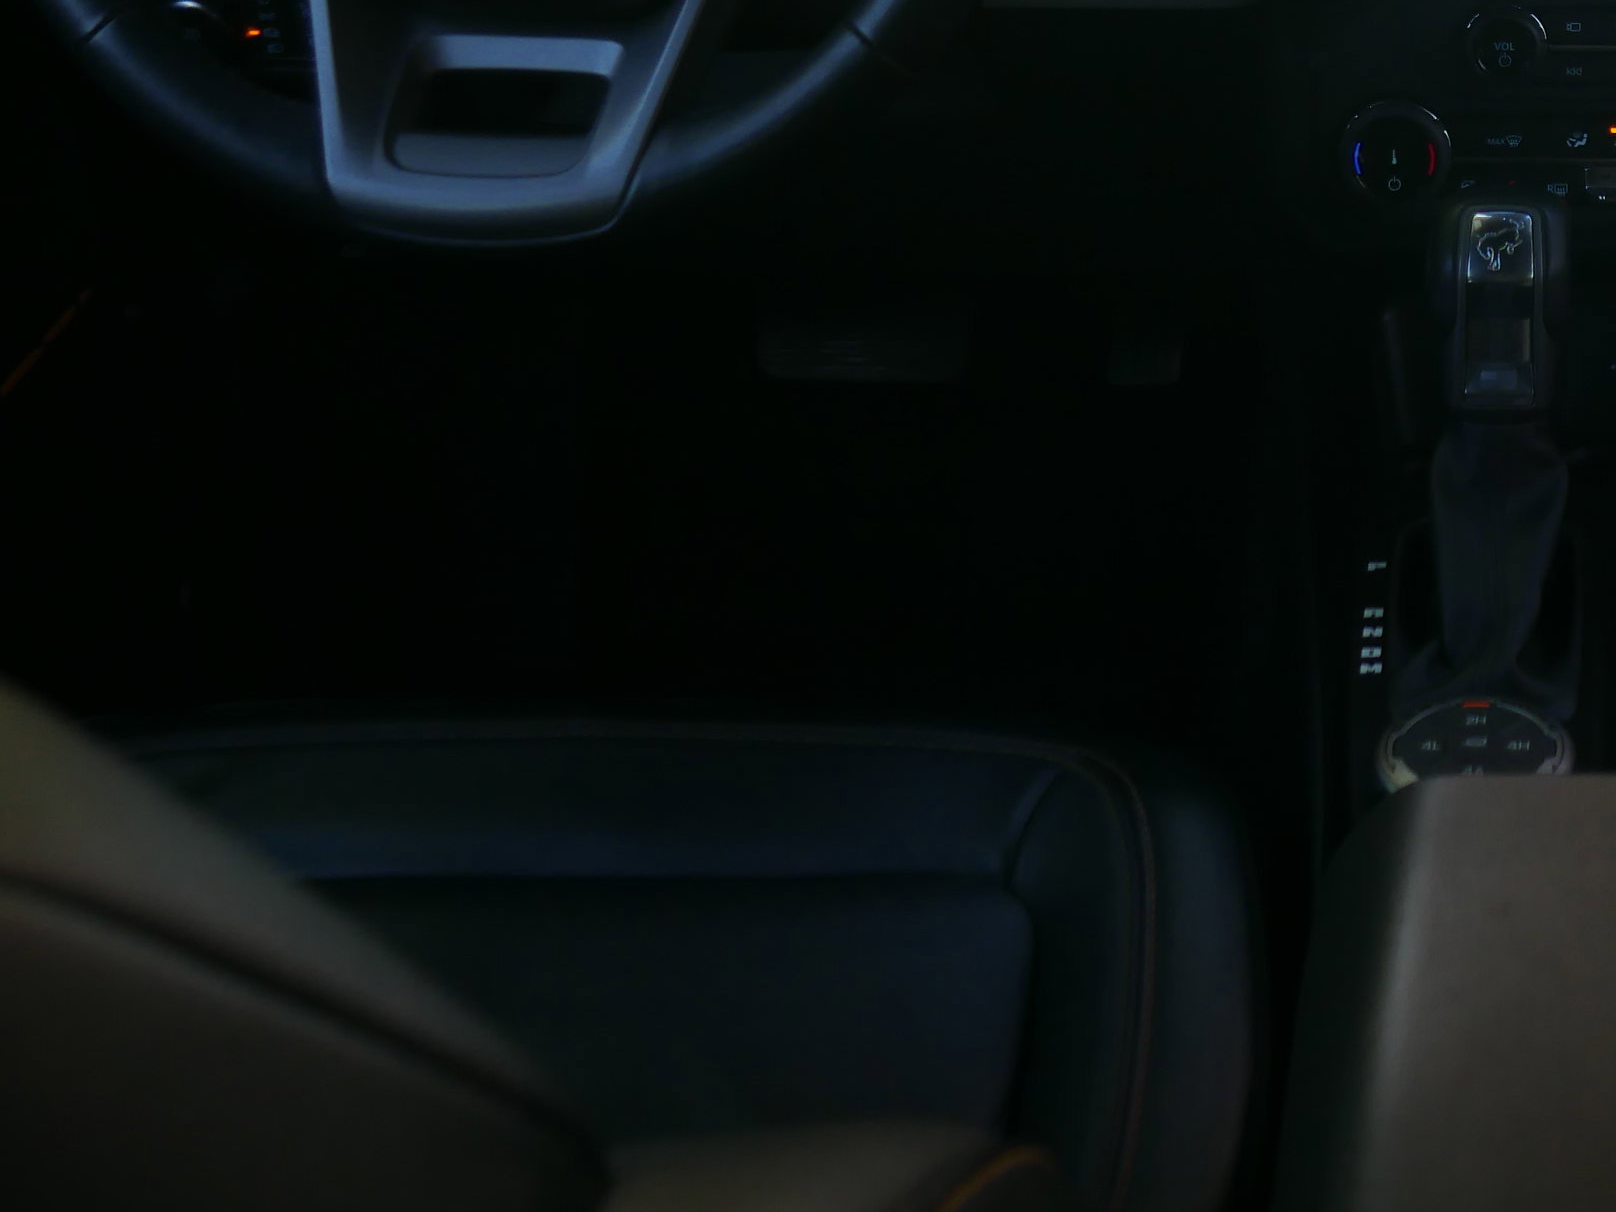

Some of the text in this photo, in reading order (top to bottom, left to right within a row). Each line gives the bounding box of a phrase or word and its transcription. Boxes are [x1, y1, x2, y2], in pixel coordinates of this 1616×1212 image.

[1494, 42, 1515, 52] VOL
[1362, 627, 1383, 637] N
[1360, 663, 1382, 674] M
[1422, 741, 1440, 751] 4L
[1507, 741, 1530, 751] 4H
